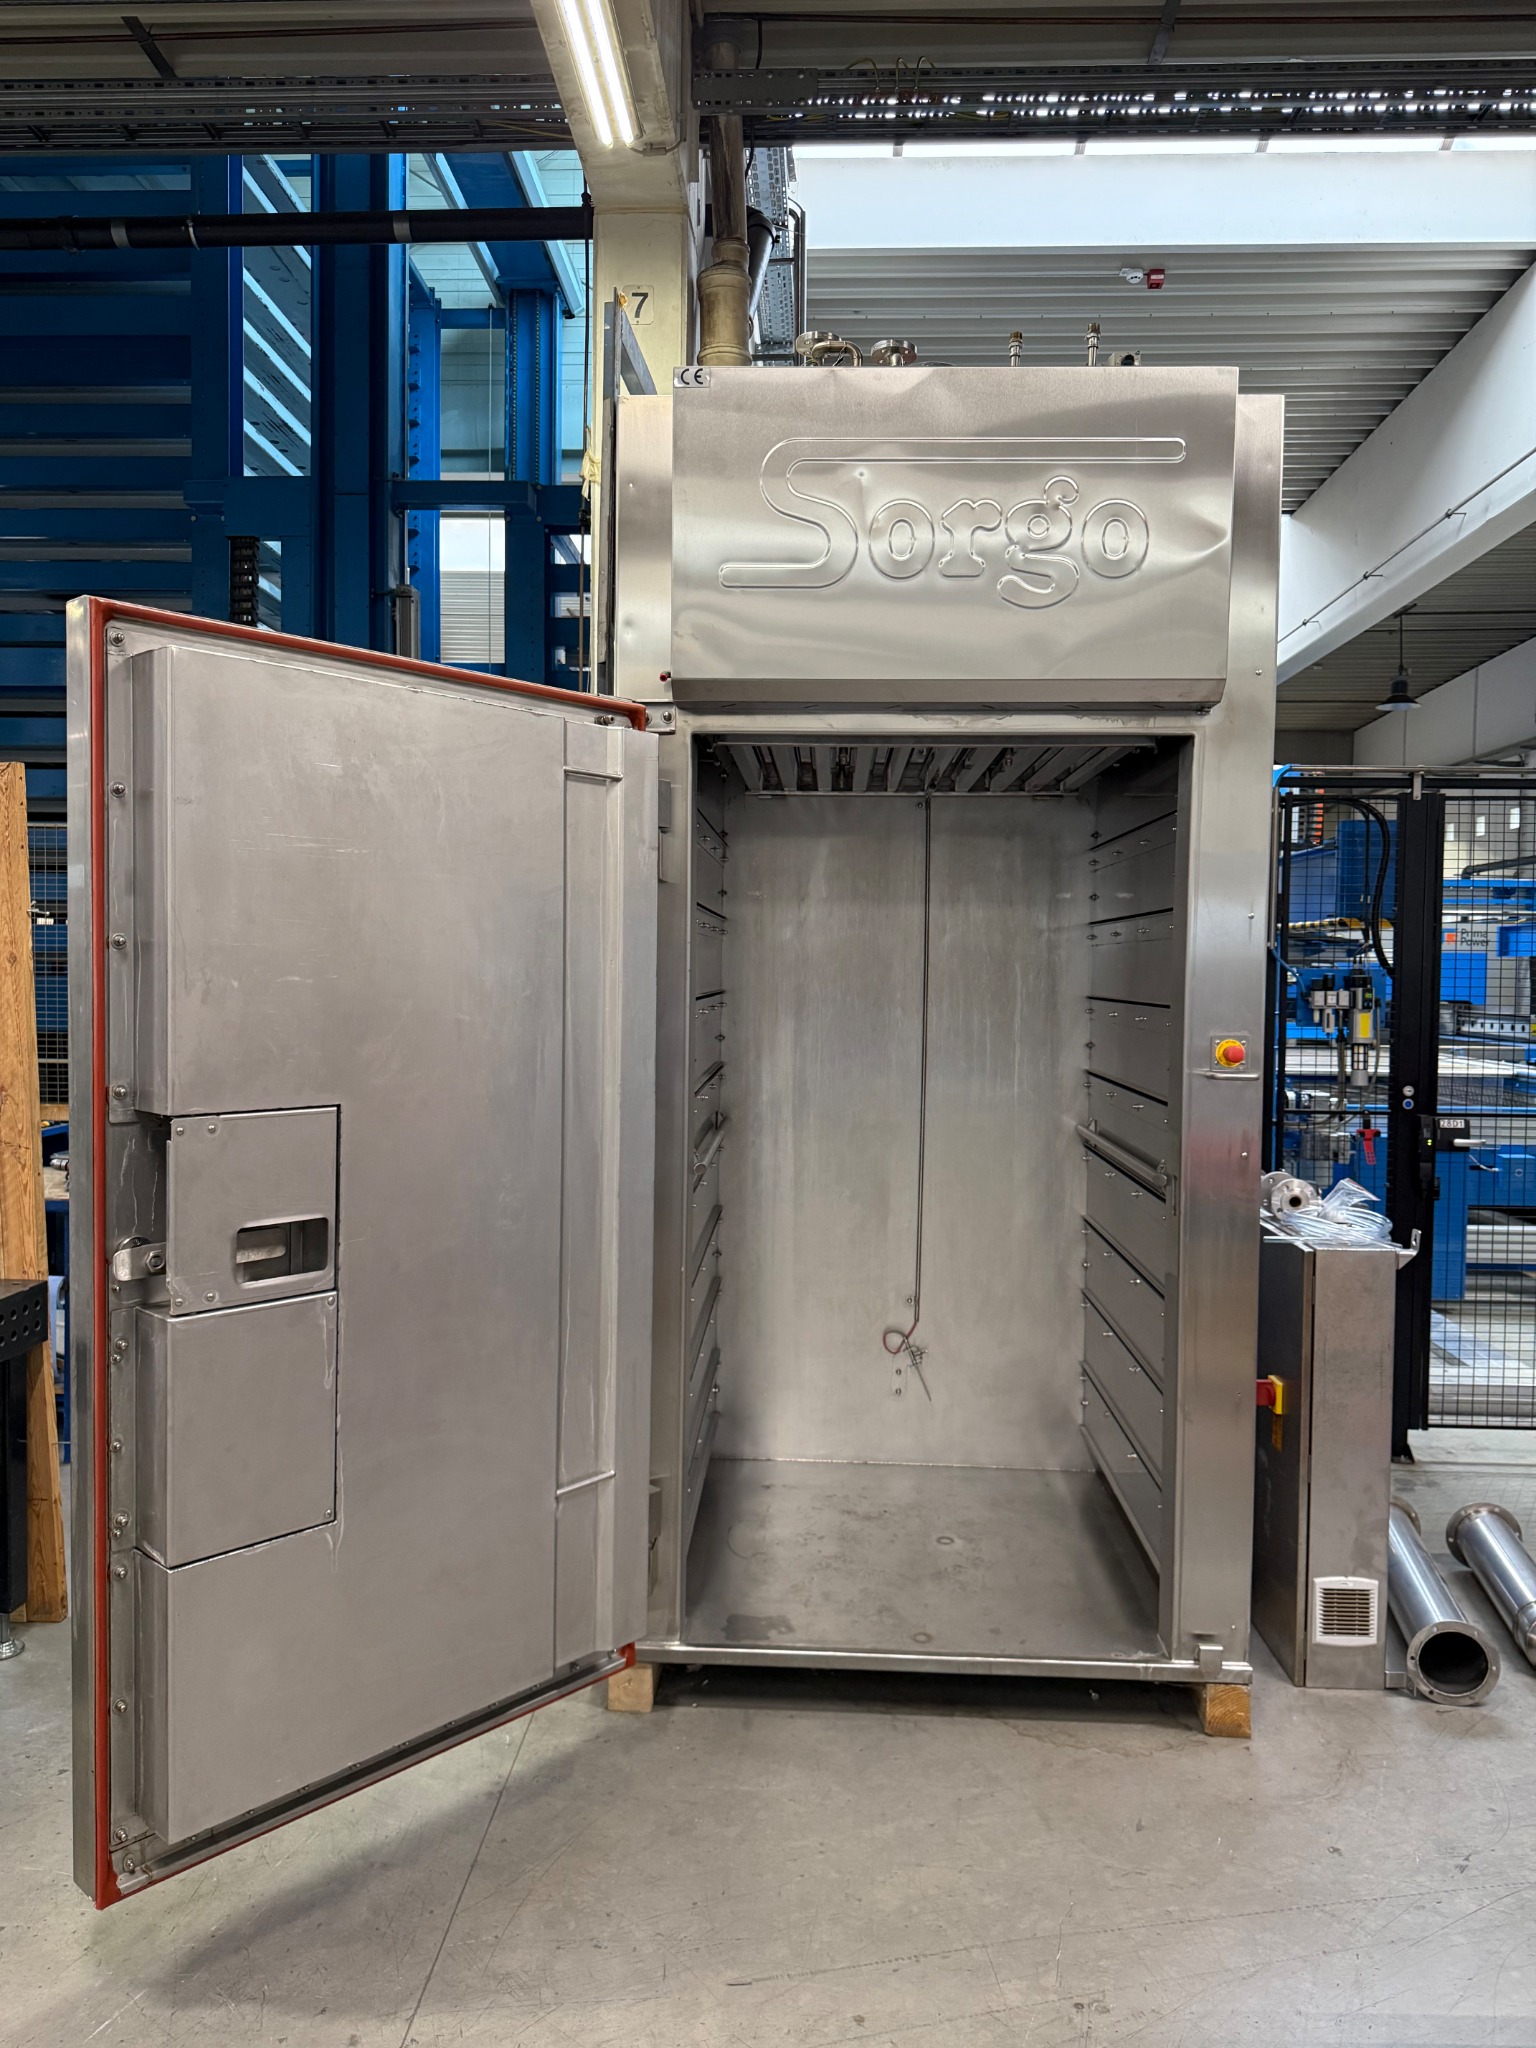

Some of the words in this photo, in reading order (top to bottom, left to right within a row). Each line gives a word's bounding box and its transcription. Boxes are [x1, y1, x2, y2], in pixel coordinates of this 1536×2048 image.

[631, 292, 649, 319] 7
[680, 368, 704, 385] CE
[718, 437, 1187, 609] Sorgo
[1460, 928, 1488, 938] Prma
